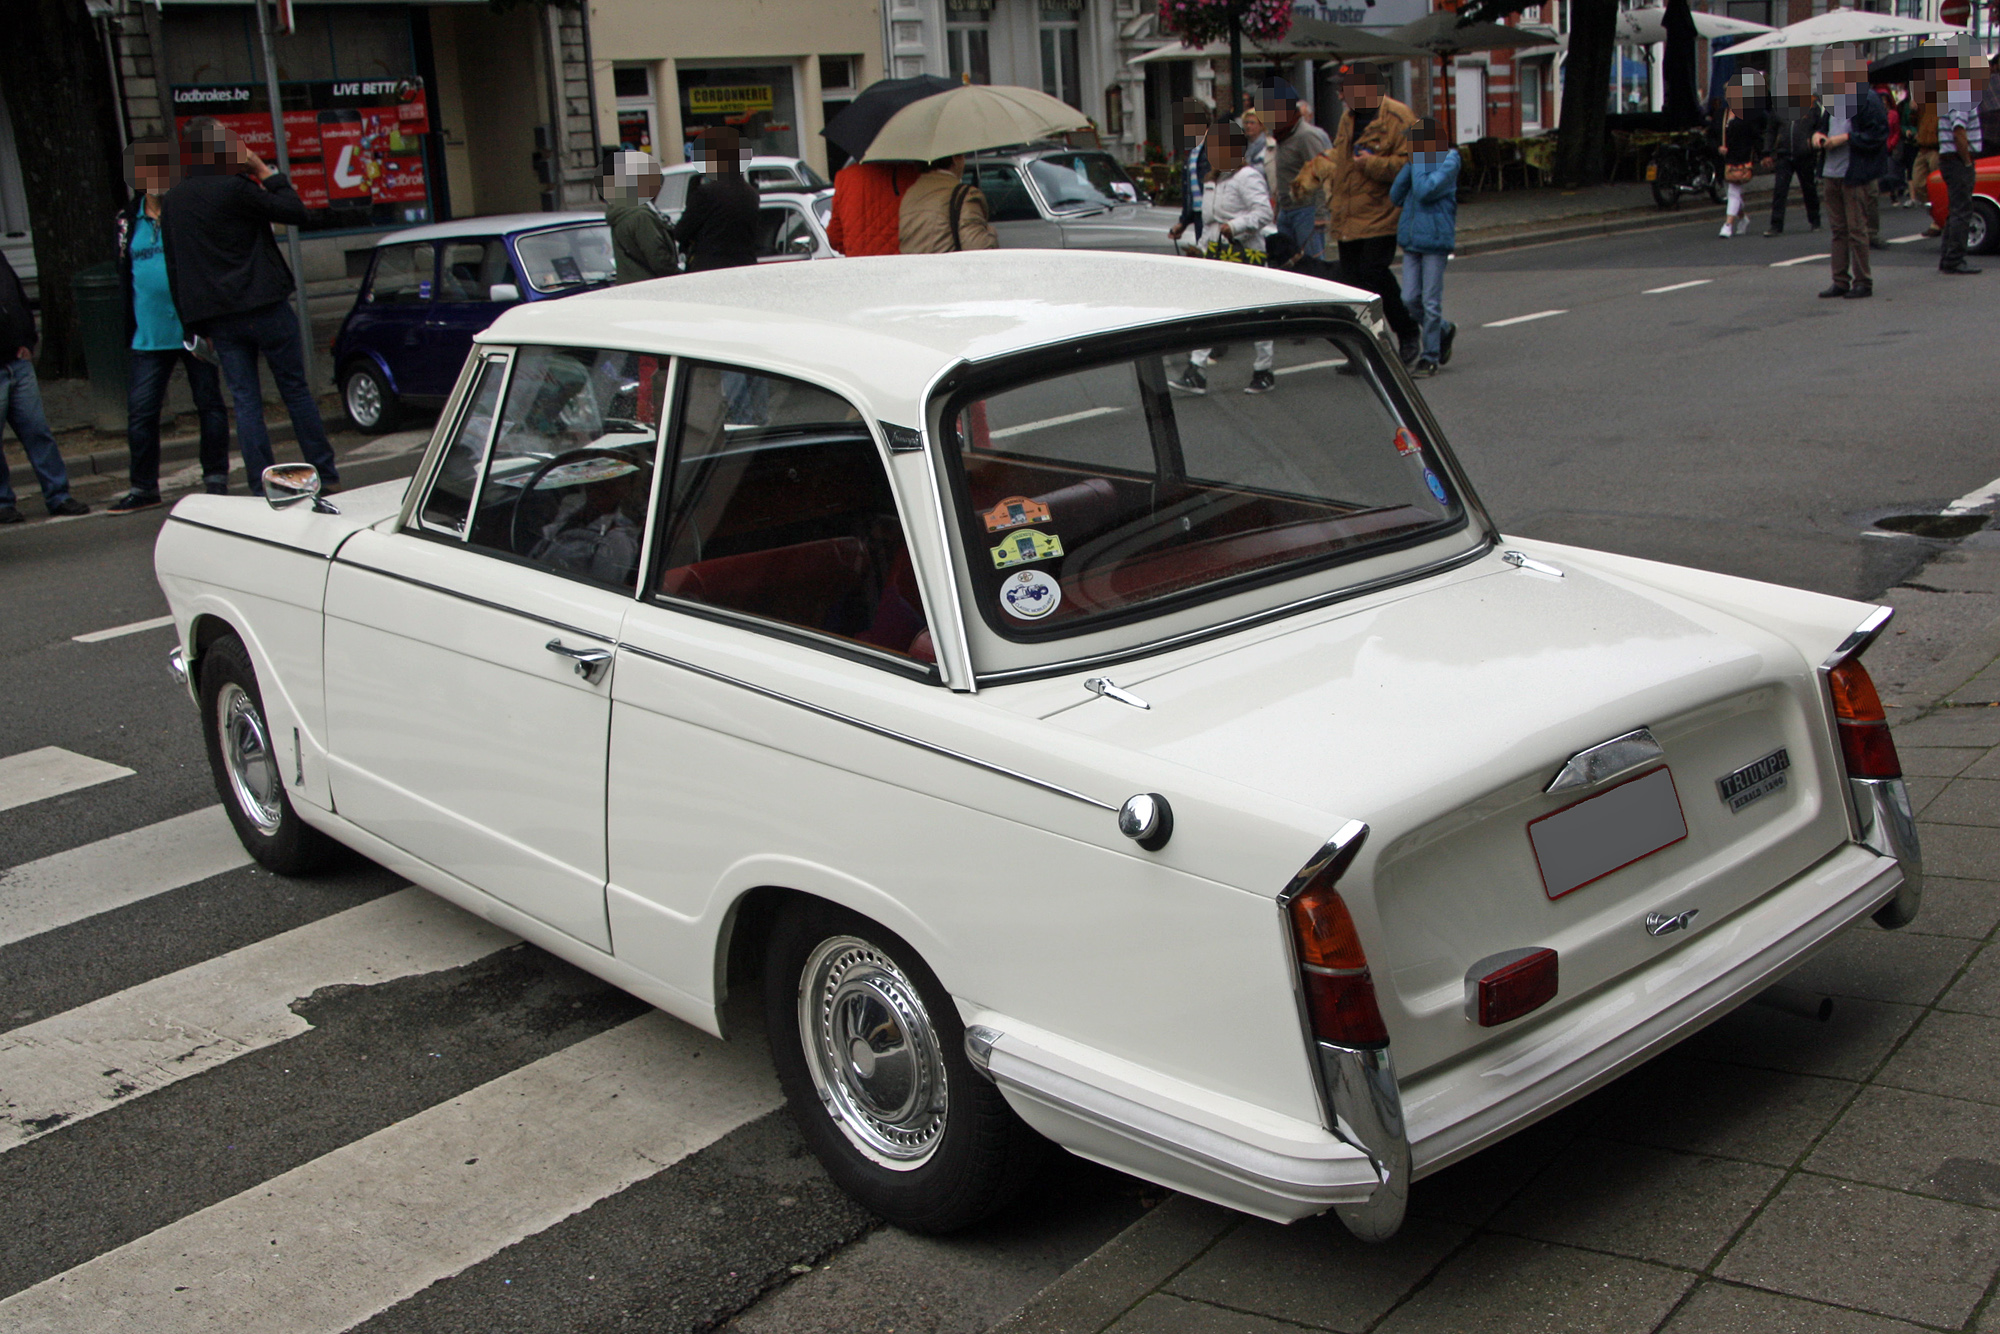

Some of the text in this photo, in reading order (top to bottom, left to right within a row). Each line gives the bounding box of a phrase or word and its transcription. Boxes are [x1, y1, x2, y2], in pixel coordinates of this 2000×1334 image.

[1320, 5, 1366, 23] Twister
[174, 88, 250, 102] Ladbrokes.be
[333, 83, 360, 96] LIVE
[694, 87, 768, 103] CORDONNERIE
[1723, 751, 1789, 796] TRIUMPH
[1734, 788, 1762, 808] HERALD
